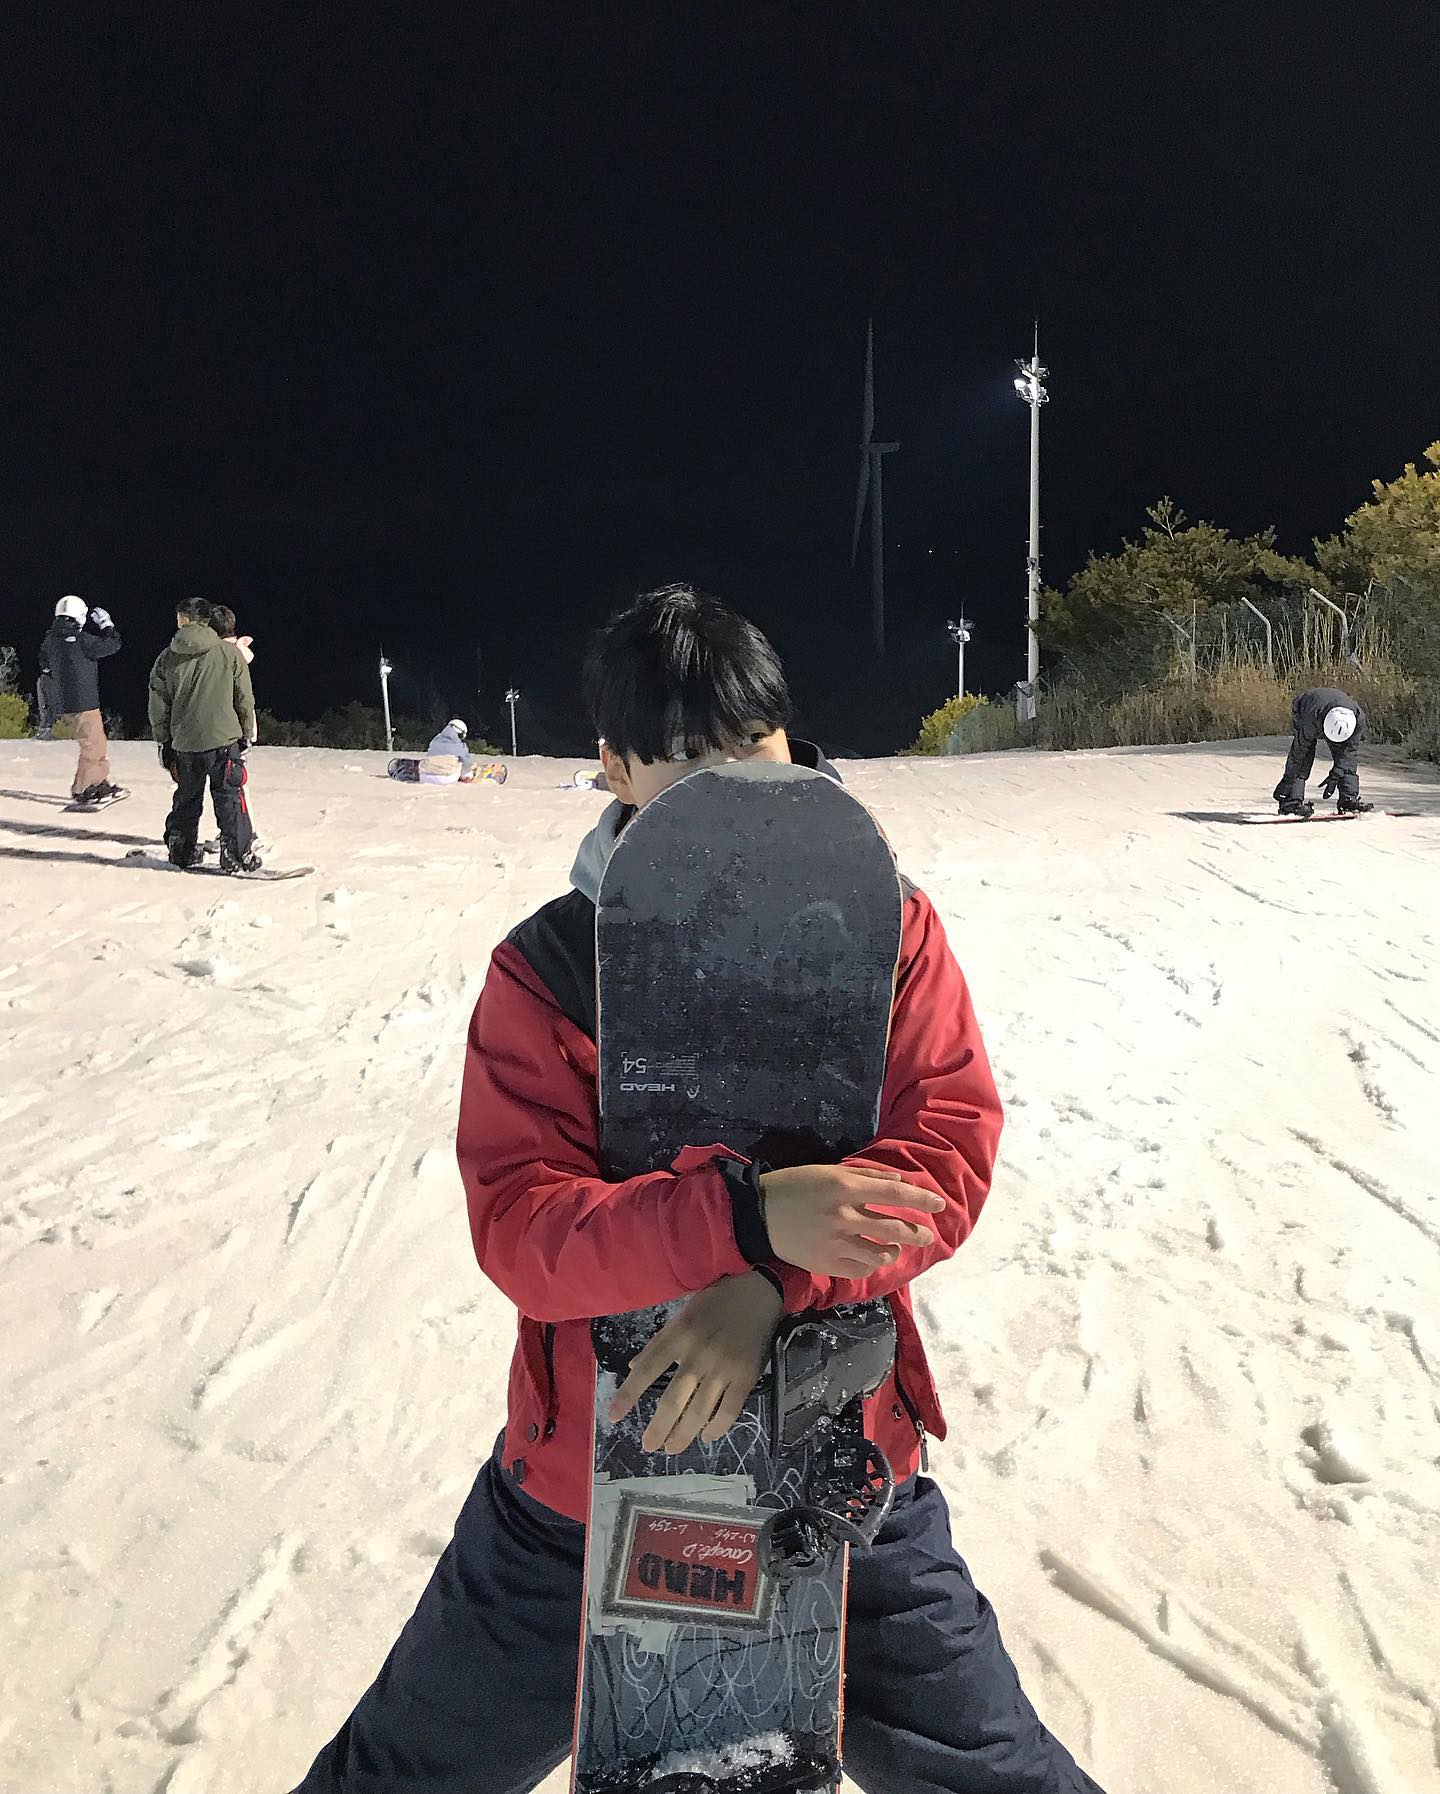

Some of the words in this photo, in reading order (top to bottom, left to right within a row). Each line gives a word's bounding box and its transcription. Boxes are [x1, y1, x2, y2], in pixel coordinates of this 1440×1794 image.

[622, 1058, 647, 1074] 54
[620, 1083, 676, 1092] HEAD
[638, 1552, 746, 1605] HEAD
